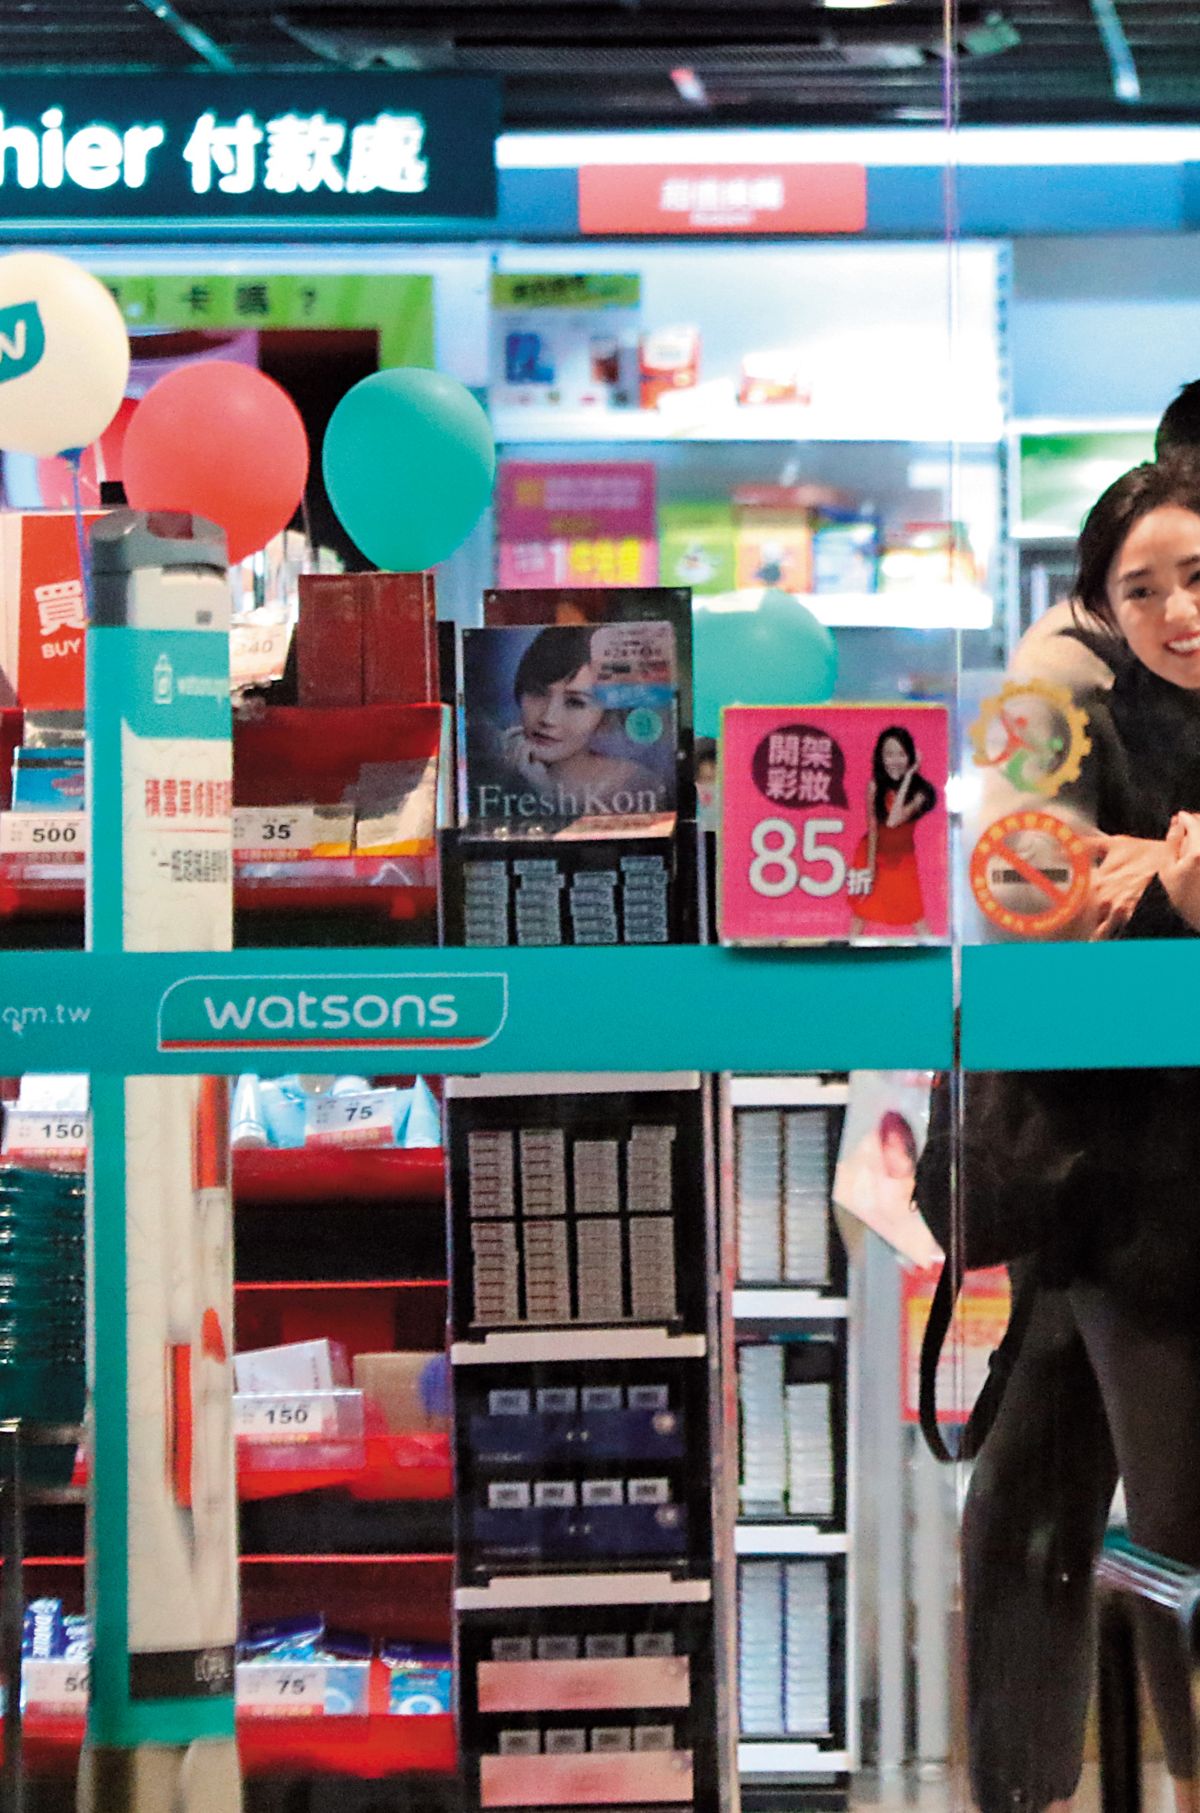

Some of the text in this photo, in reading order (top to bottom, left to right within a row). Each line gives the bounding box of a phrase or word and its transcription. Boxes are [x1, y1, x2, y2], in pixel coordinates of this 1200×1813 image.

[183, 110, 428, 194] 付款處
[33, 579, 89, 636] 買
[41, 637, 81, 659] BUY
[768, 733, 832, 769] 開架
[766, 768, 831, 803] 彩妝
[33, 827, 76, 842] 500
[262, 824, 291, 839] 35
[204, 991, 458, 1030] watsons
[345, 1105, 373, 1122] 75
[42, 1123, 84, 1139] 150
[266, 1409, 308, 1424] 150
[276, 1679, 305, 1695] 75
